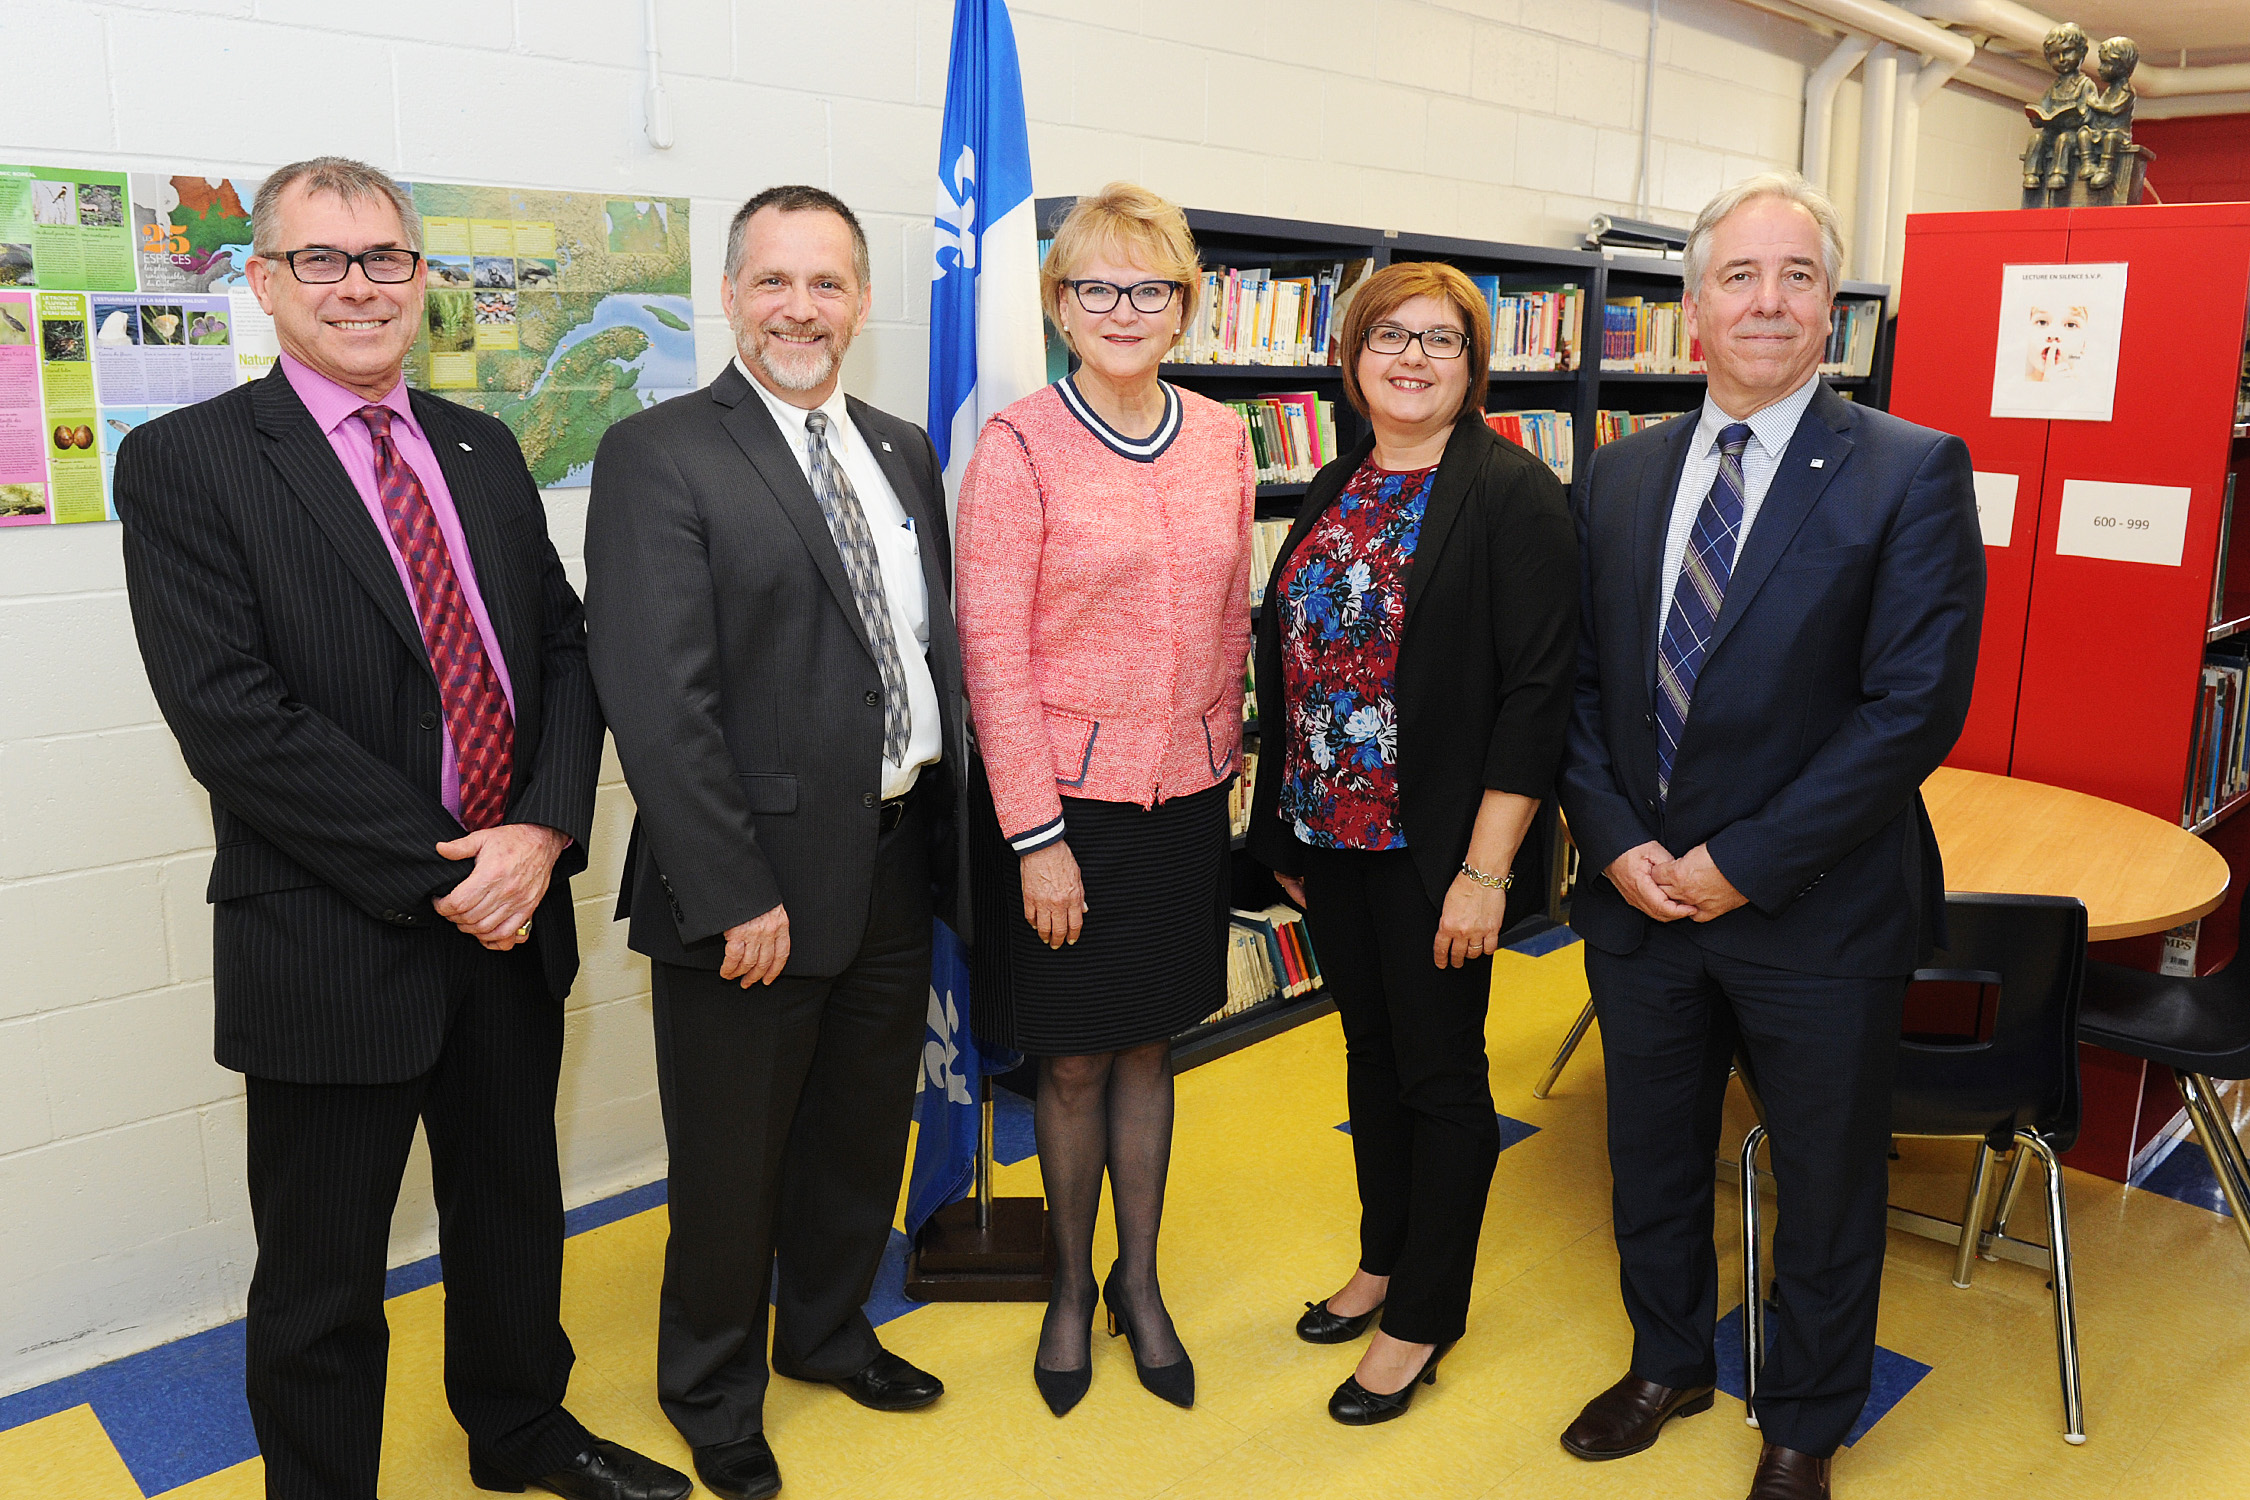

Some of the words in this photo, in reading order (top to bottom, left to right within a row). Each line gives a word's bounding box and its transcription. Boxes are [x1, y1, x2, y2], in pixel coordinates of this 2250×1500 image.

[142, 224, 191, 254] 25
[143, 250, 191, 265] ESPÈCES
[239, 353, 277, 366] Nature
[2093, 516, 2117, 528] 600
[2127, 518, 2150, 530] 999
